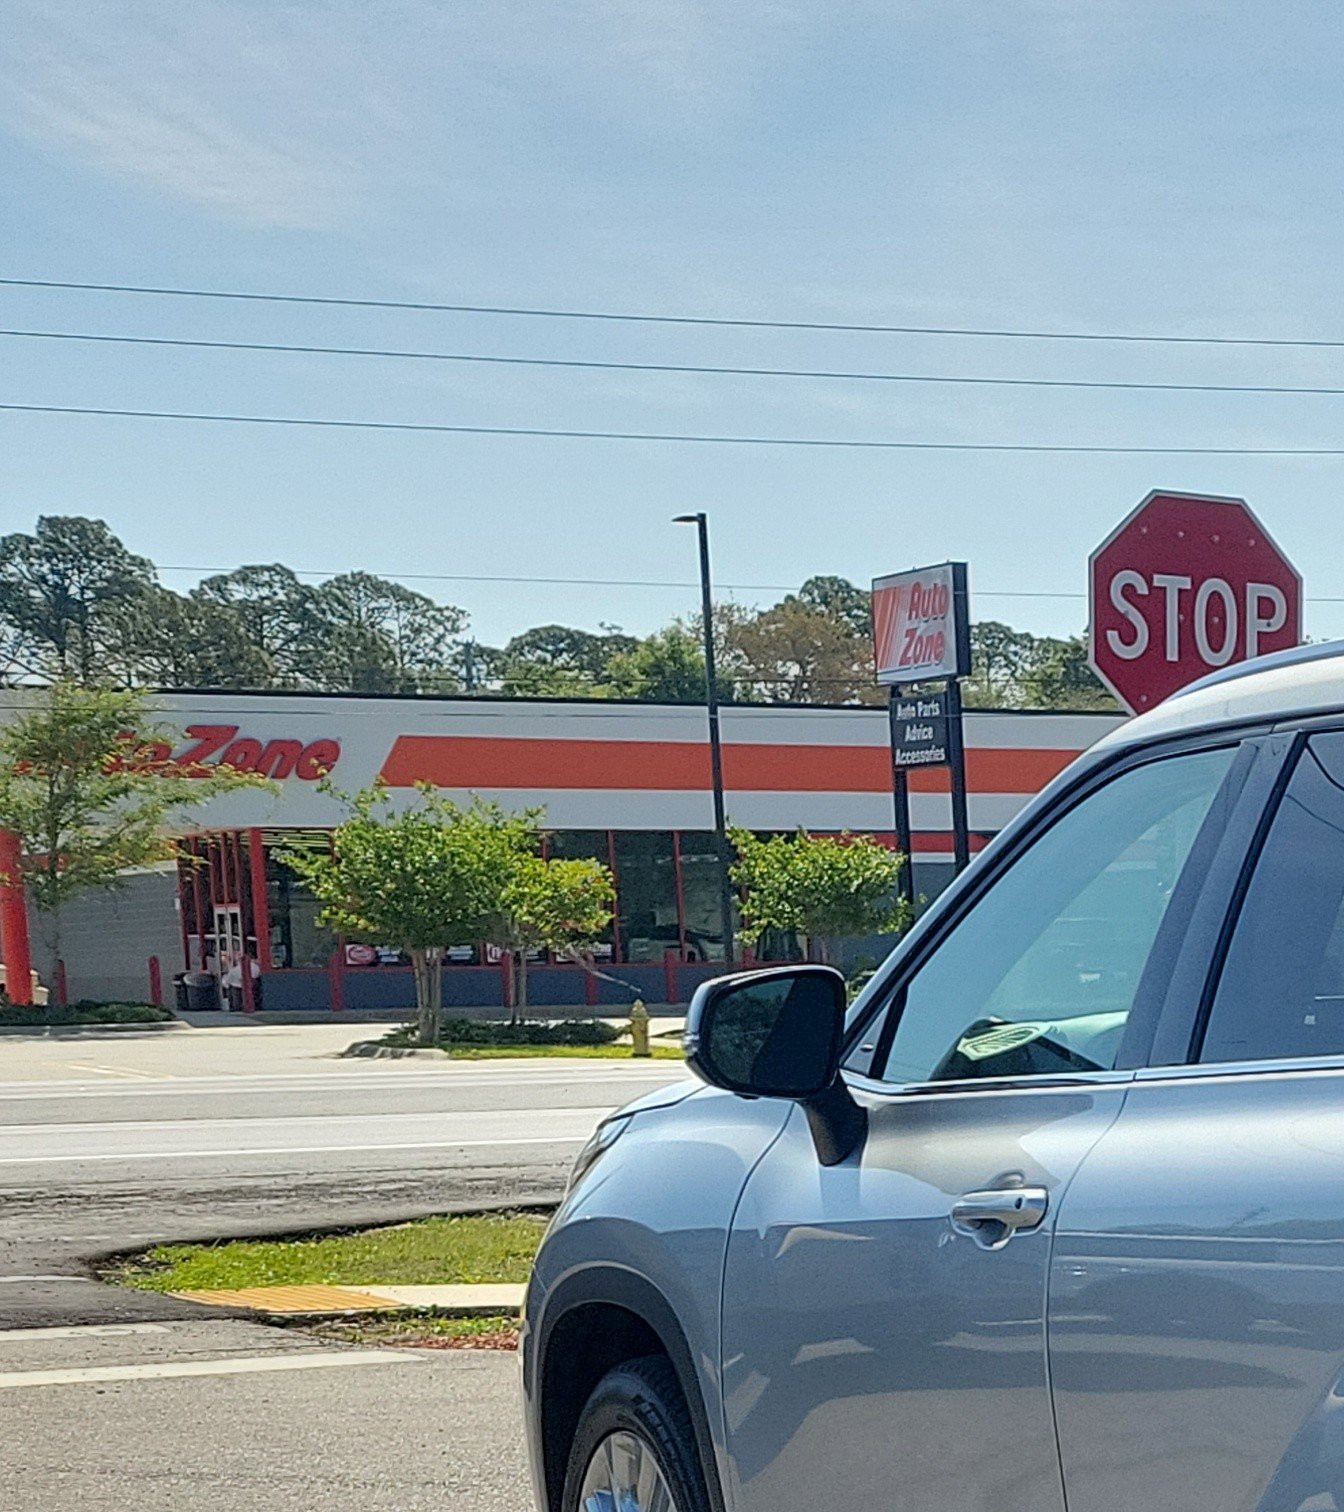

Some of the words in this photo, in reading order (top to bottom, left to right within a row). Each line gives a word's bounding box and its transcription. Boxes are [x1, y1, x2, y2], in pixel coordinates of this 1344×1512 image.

[906, 580, 949, 622] Auto
[1106, 569, 1288, 667] STOP
[898, 627, 947, 667] Zone
[896, 703, 916, 721] Auto
[917, 701, 941, 717] Parts
[904, 723, 934, 742] Advice
[894, 745, 946, 767] Accessories
